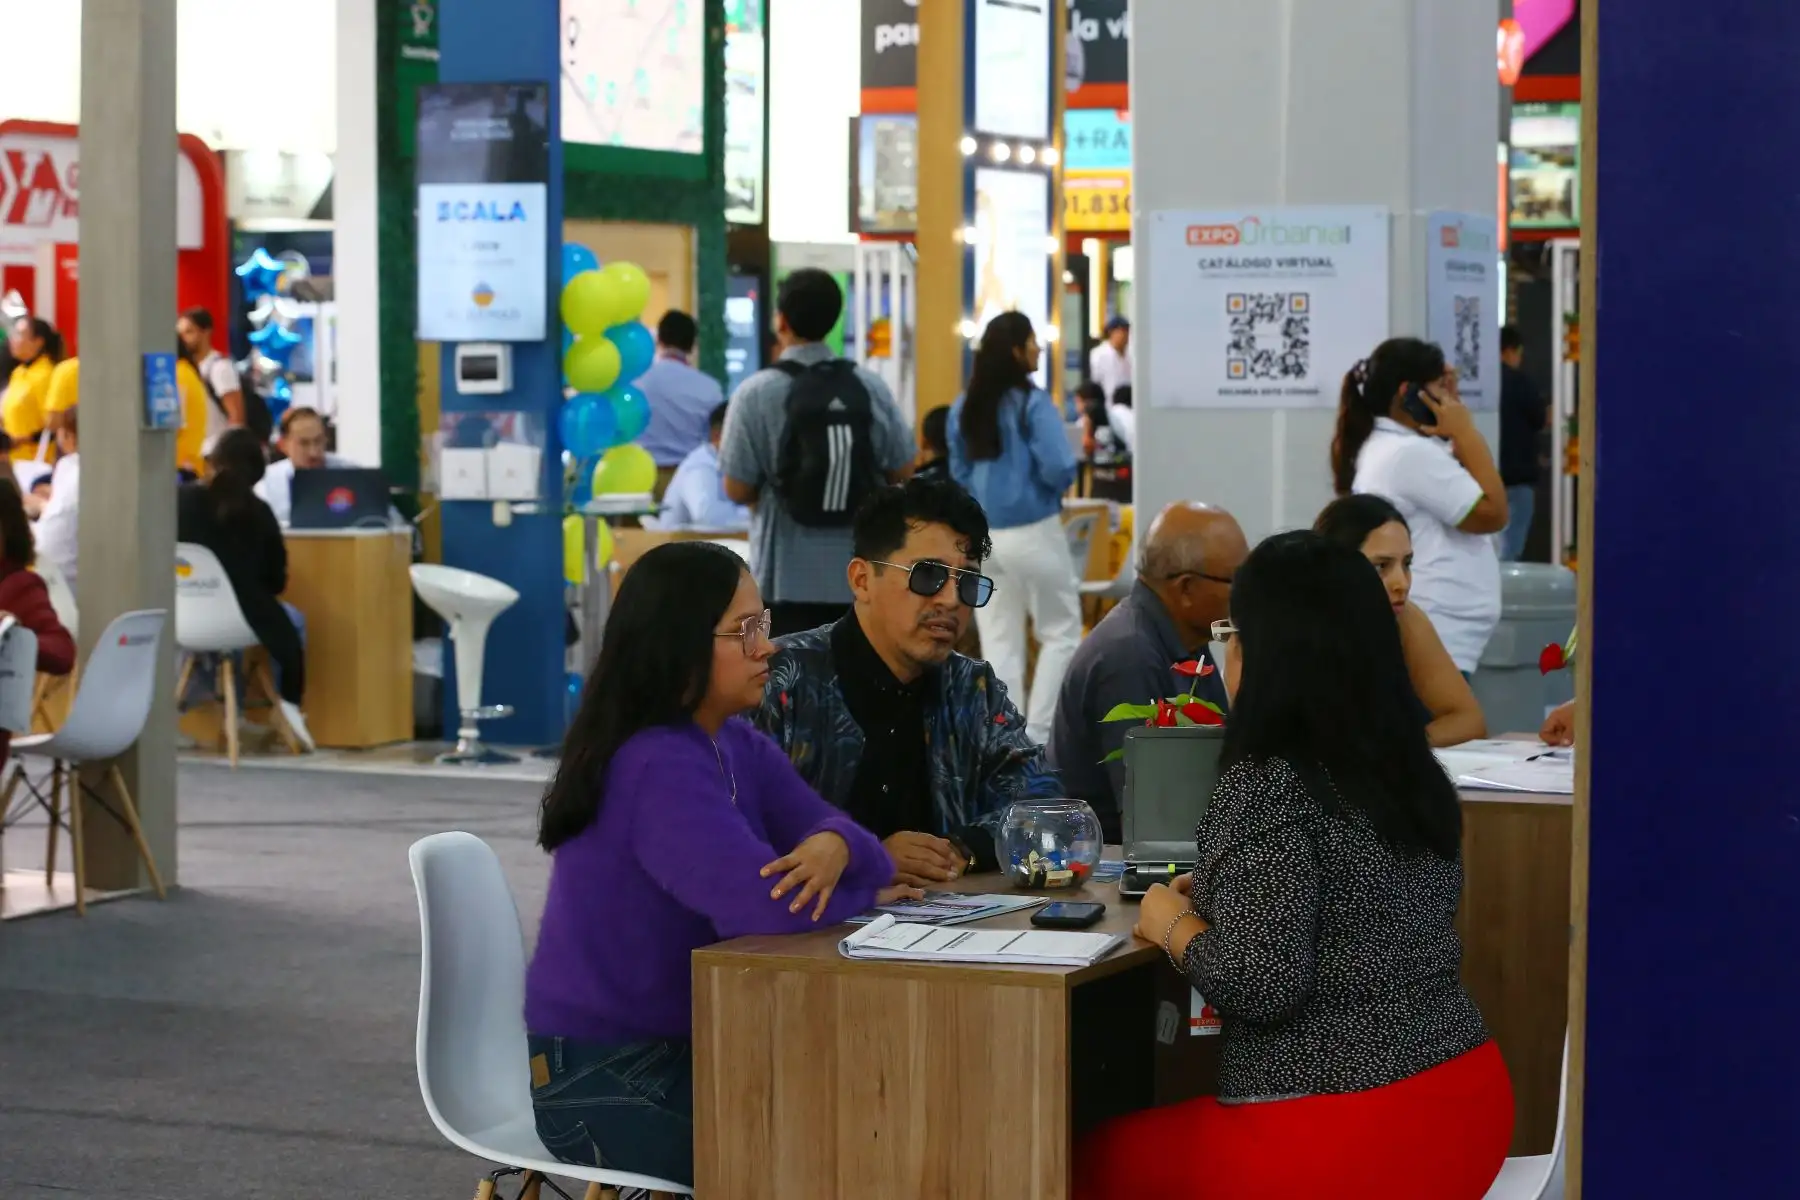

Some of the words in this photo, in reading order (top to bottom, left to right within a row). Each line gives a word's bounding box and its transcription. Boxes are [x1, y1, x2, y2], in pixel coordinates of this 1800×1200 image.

[1071, 10, 1099, 41] la
[1189, 228, 1237, 244] EXPO
[1199, 256, 1272, 270] CATÁLOGO
[1277, 257, 1334, 269] VIRTUAL
